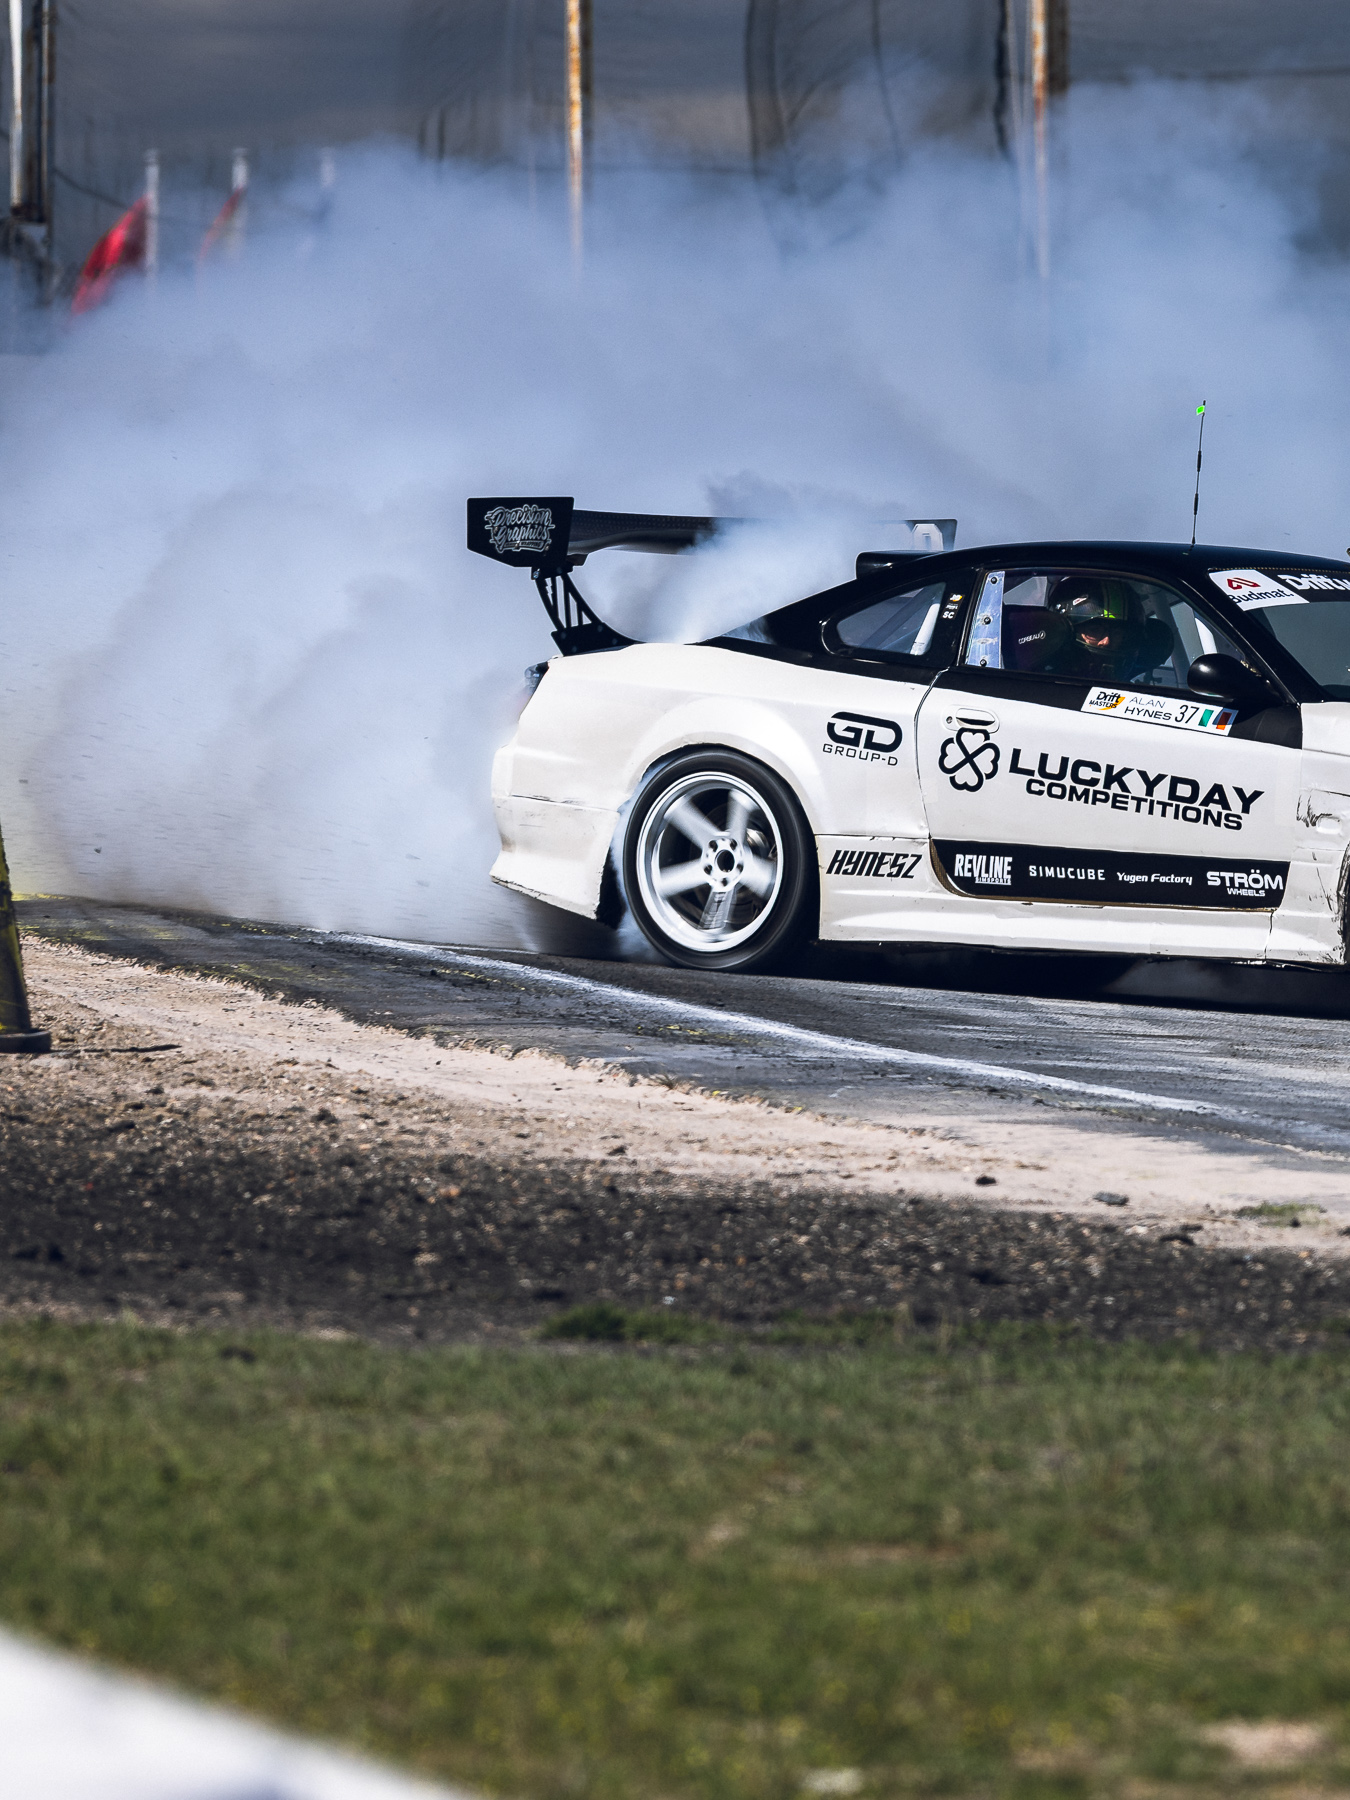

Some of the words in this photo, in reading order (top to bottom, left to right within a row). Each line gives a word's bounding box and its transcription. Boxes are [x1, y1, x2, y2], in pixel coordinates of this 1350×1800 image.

[486, 505, 550, 527] Precision
[493, 522, 548, 551] Graphics
[942, 611, 955, 619] SC
[1089, 699, 1118, 709] MASTERS
[1096, 691, 1121, 703] Drift
[1129, 696, 1166, 709] ALAN
[1124, 706, 1172, 721] HYNES
[1174, 704, 1200, 724] 37
[822, 743, 899, 766] GROUP-D
[1009, 748, 1265, 815] LUCKYDAY
[1026, 778, 1243, 831] COMPETITIONS
[826, 849, 922, 879] HYNESZ
[954, 853, 1013, 878] REVLINE
[1029, 865, 1106, 881] SIMUCUBE
[975, 877, 1012, 886] SIMSPORTS
[1116, 872, 1149, 884] Yugen
[1151, 873, 1193, 886] Factory
[1206, 869, 1284, 890] STRÖM
[1227, 887, 1266, 897] WHEELS
